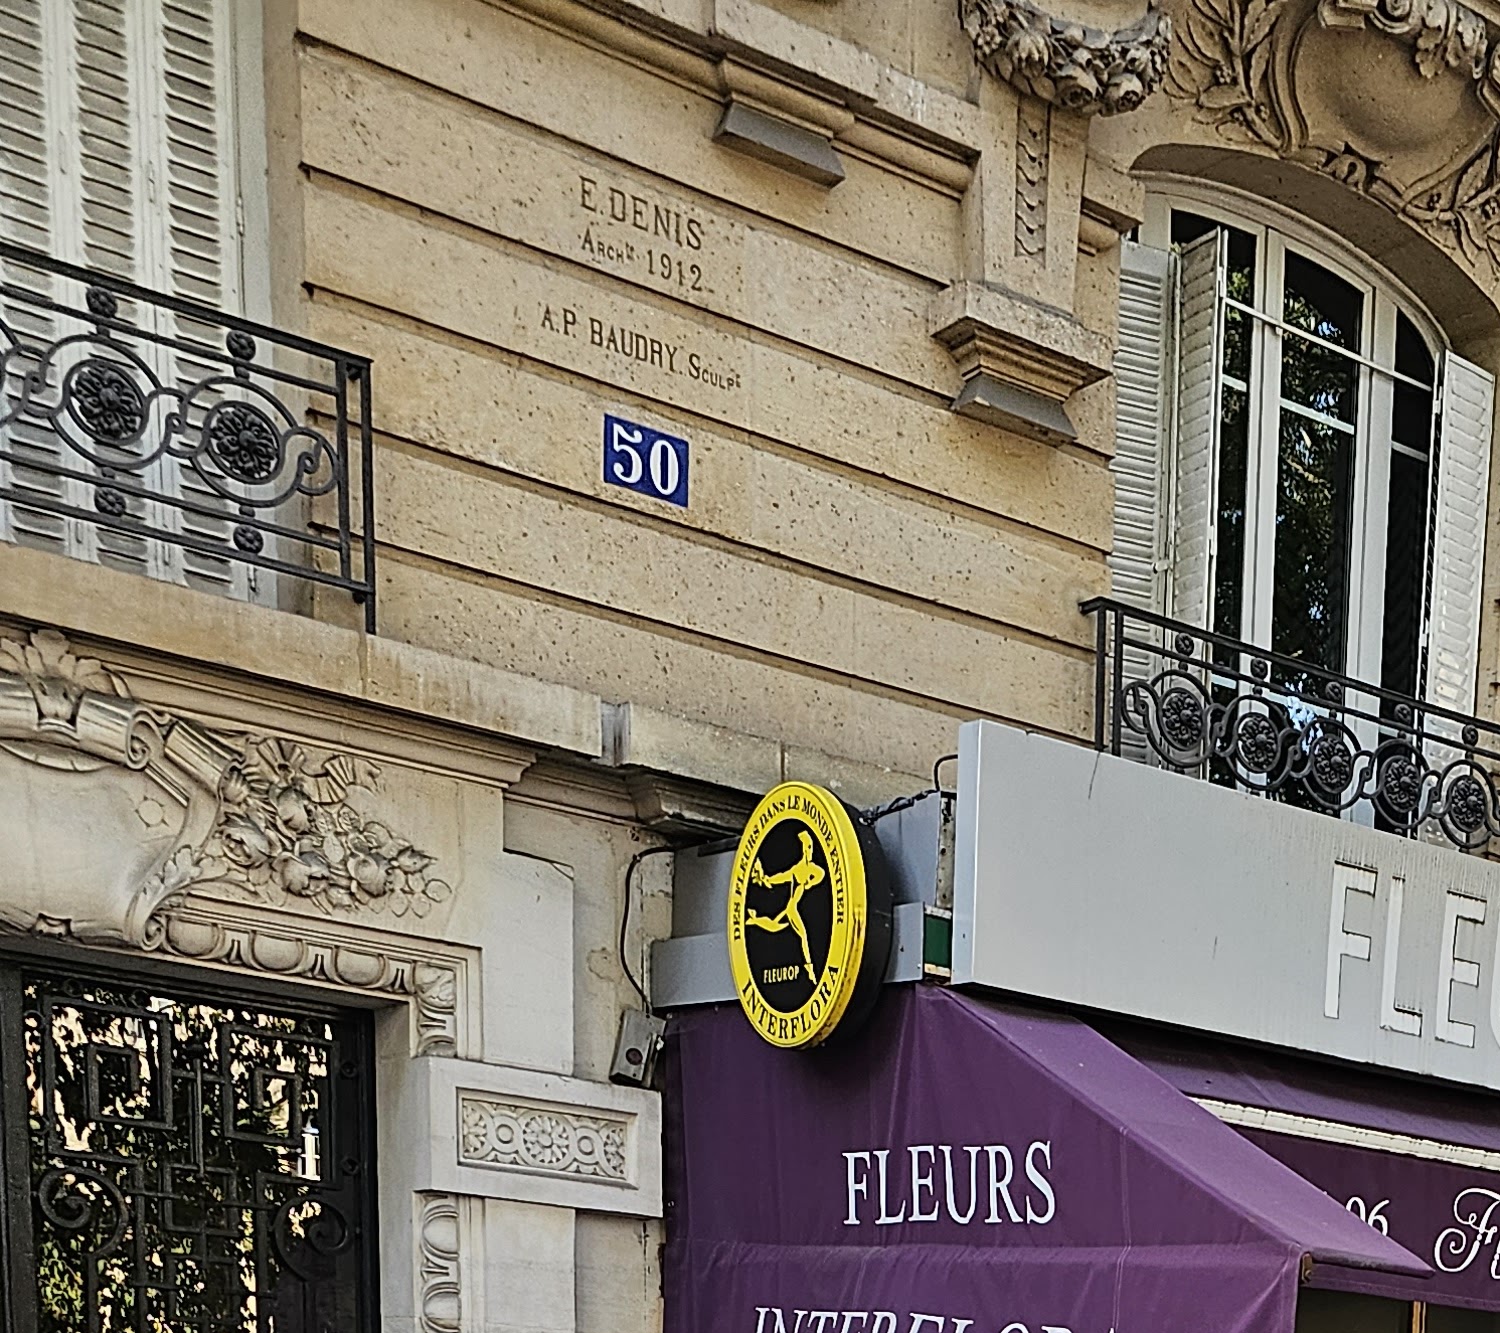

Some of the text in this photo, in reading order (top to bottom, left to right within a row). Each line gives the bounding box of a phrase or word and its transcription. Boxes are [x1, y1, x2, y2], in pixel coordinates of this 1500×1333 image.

[611, 422, 680, 496] 50
[733, 795, 845, 941] DES FLEURS DANS LE MONDE ENTIER
[741, 965, 839, 1040] INTERFLORA
[763, 965, 800, 985] FLEUROP
[842, 1140, 1056, 1226] FLEURS
